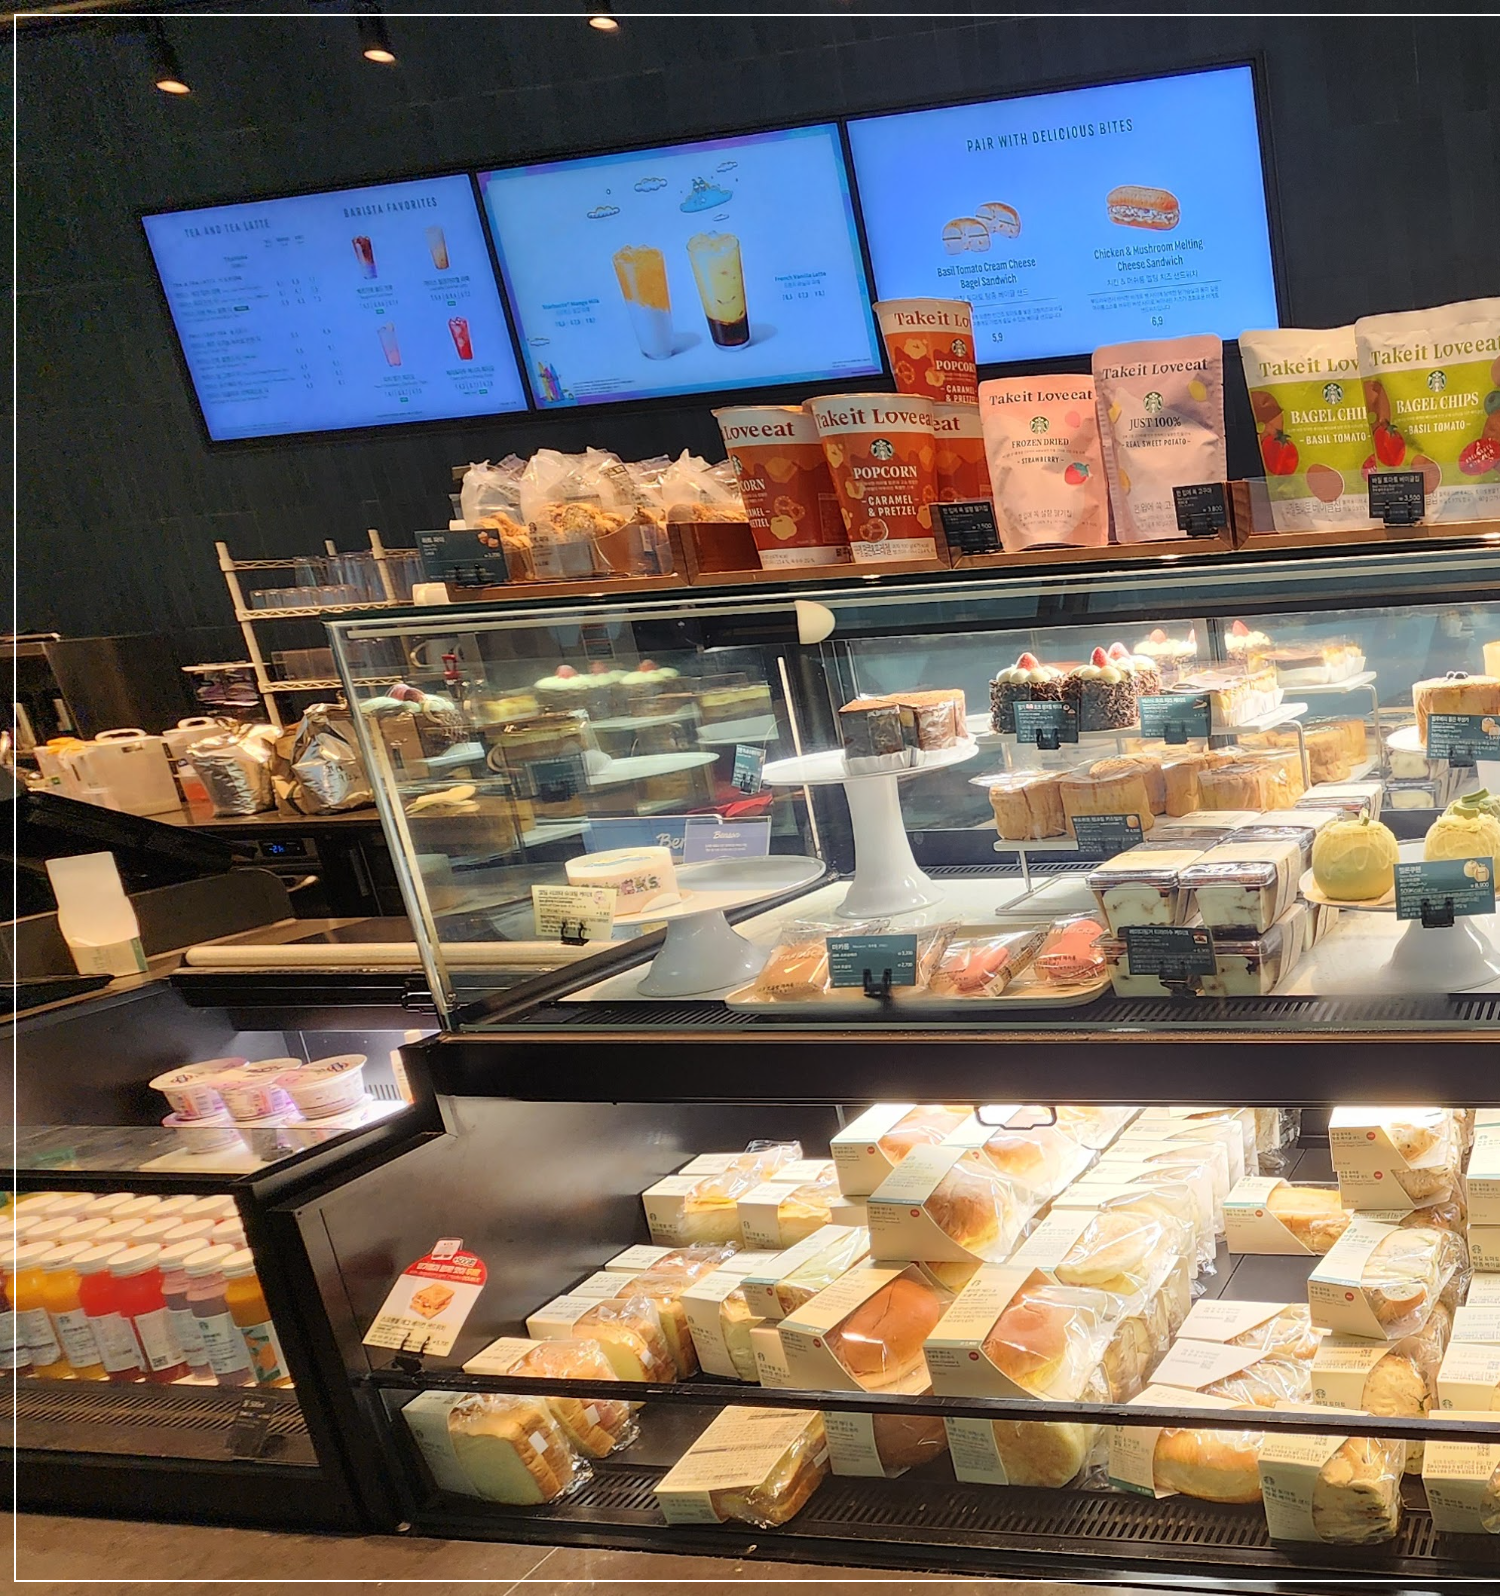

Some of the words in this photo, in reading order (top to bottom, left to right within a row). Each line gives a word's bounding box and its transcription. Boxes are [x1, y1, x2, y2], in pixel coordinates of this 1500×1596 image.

[966, 137, 995, 153] PAIR
[999, 133, 1028, 149] WITH
[1032, 124, 1095, 145] DELICIOUS
[1099, 118, 1134, 136] BITES
[344, 204, 384, 218] BARISTA
[386, 197, 438, 214] FAVORITES
[1094, 247, 1125, 259] Chicken
[1125, 246, 1132, 256] &
[1132, 242, 1174, 255] Mushroom
[1174, 239, 1204, 251] Melting
[937, 266, 955, 277] Basil
[956, 264, 983, 275] Tomato
[983, 261, 1008, 272] Cream
[1009, 258, 1036, 269] Cheese
[1117, 260, 1145, 272] Cheese
[1146, 255, 1184, 269] Sandwich
[960, 278, 981, 291] Bagel
[982, 274, 1017, 287] Sandwich
[894, 311, 936, 327] Take
[1151, 316, 1163, 327] 6,9
[992, 332, 1004, 343] 5,9
[1371, 347, 1412, 366] Take
[1433, 340, 1473, 358] Love
[1103, 367, 1136, 380] Take
[1151, 361, 1184, 375] Love
[1259, 360, 1305, 378] Take
[989, 393, 1022, 406] Take
[1037, 390, 1069, 402] Love
[1396, 397, 1438, 414] BAGEL
[1440, 391, 1479, 409] CHIPS
[817, 411, 849, 429] Take
[873, 408, 915, 425] Love
[1129, 418, 1152, 431] JUST
[1154, 416, 1182, 428] 100%
[1291, 409, 1335, 424] BAGEL
[1408, 423, 1431, 434] BASIL
[1433, 420, 1466, 432] TOMATO
[1011, 439, 1042, 448] FROZEN
[1042, 437, 1070, 446] DRIED
[1125, 439, 1140, 448] REAL
[1142, 438, 1161, 447] SWEET
[1164, 438, 1187, 447] POTATO
[1306, 434, 1330, 445] BASIL
[1333, 432, 1366, 443] TOMATO
[1021, 456, 1060, 464] STRAWBERRY
[853, 466, 917, 480] POPCORN
[868, 495, 913, 507] CARAMEL
[868, 507, 876, 517] &
[878, 505, 916, 517] PRETZEL
